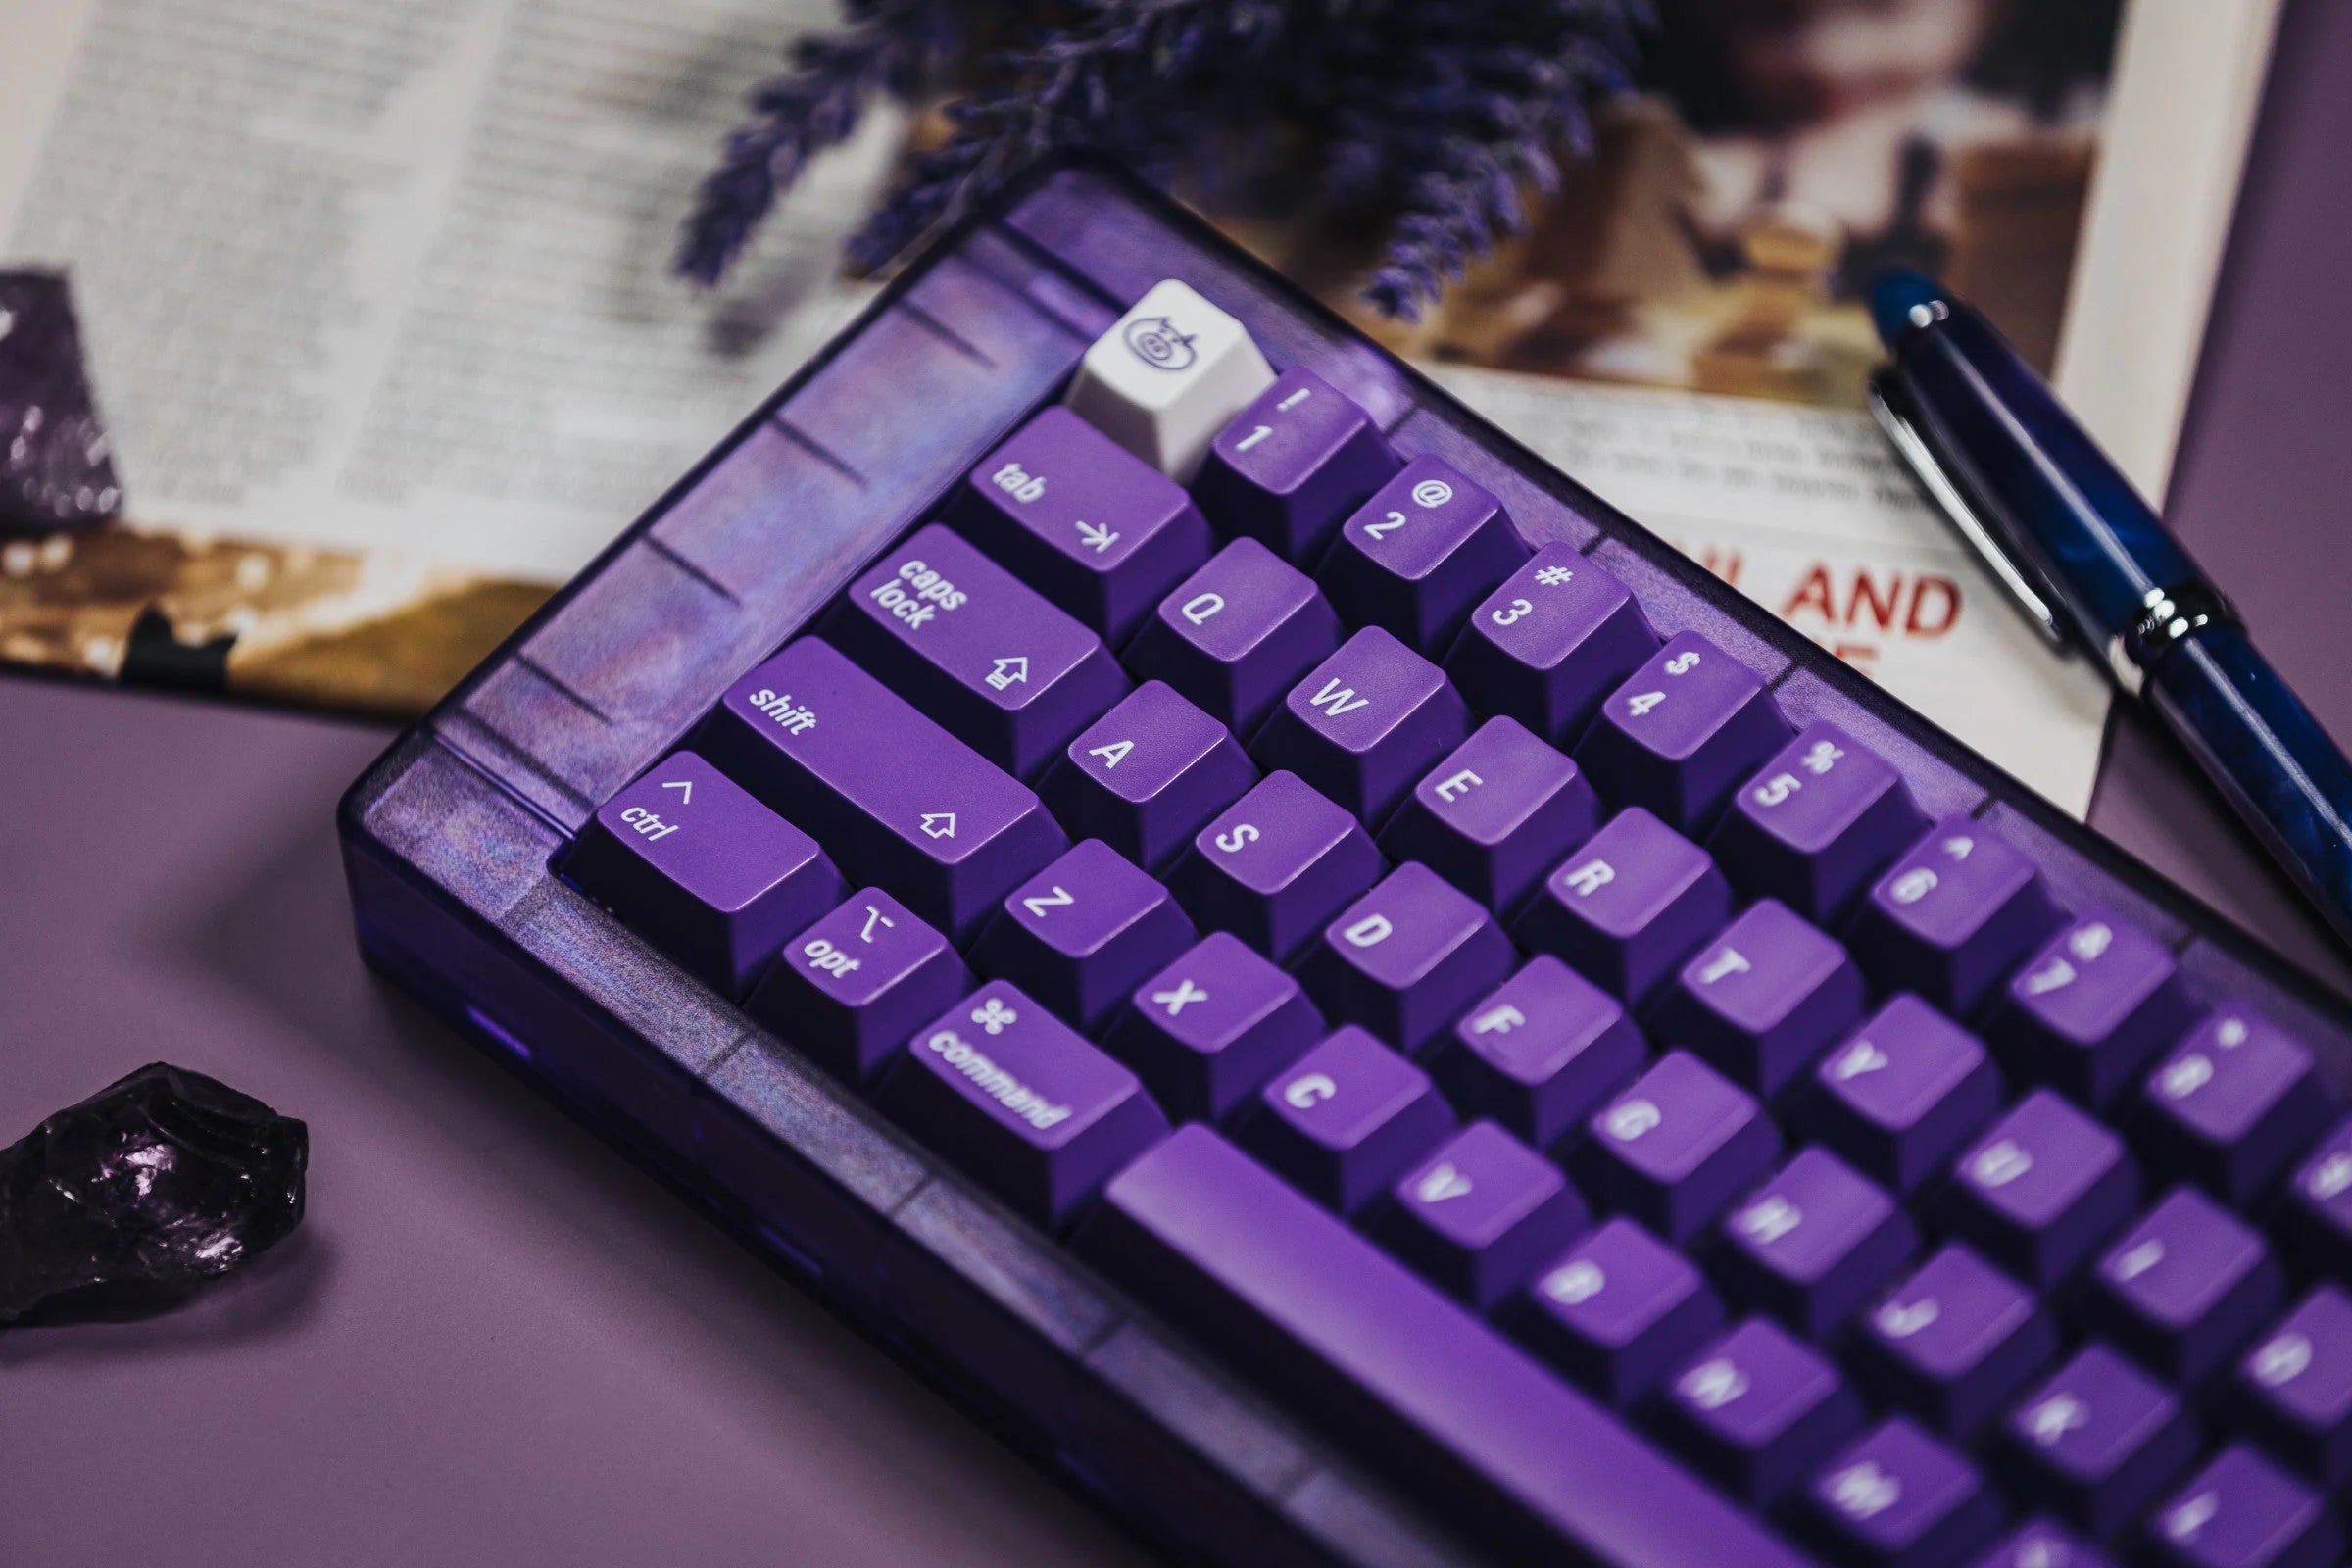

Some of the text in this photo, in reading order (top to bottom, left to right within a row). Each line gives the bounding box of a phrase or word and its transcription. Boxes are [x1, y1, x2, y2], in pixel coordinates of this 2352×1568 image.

[1275, 387, 1311, 413] !
[1237, 426, 1272, 450] 1
[993, 464, 1045, 502] tab
[1412, 480, 1452, 508] @
[1364, 512, 1406, 539] 2
[898, 560, 968, 611] caps
[1533, 564, 1575, 588] #
[869, 578, 936, 630] lock
[1182, 593, 1224, 624] Q
[1493, 599, 1533, 625] 3
[1778, 558, 1965, 639] AND
[1666, 652, 1700, 674] $
[750, 690, 816, 735] shift
[1310, 678, 1369, 716] W
[1630, 692, 1666, 715] 4
[1089, 741, 1134, 769] A
[1436, 770, 1483, 802] E
[1756, 774, 1801, 805] 5
[621, 808, 679, 841] ctrl
[1216, 824, 1259, 852] S
[1567, 860, 1614, 895] R
[1891, 868, 1939, 905] 6
[1024, 887, 1073, 916] Z
[1345, 914, 1392, 946] D
[805, 940, 859, 978] opt
[1701, 947, 1751, 984] T
[2029, 958, 2080, 995] 7
[1153, 980, 1206, 1014] X
[1475, 1006, 1524, 1032] F
[1838, 1042, 1887, 1080] Y
[929, 1032, 1071, 1128] command
[1287, 1075, 1335, 1107] C
[1607, 1101, 1662, 1141] G
[1972, 1141, 2034, 1188] U
[1418, 1165, 1472, 1202] V
[1879, 1299, 1940, 1338] J
